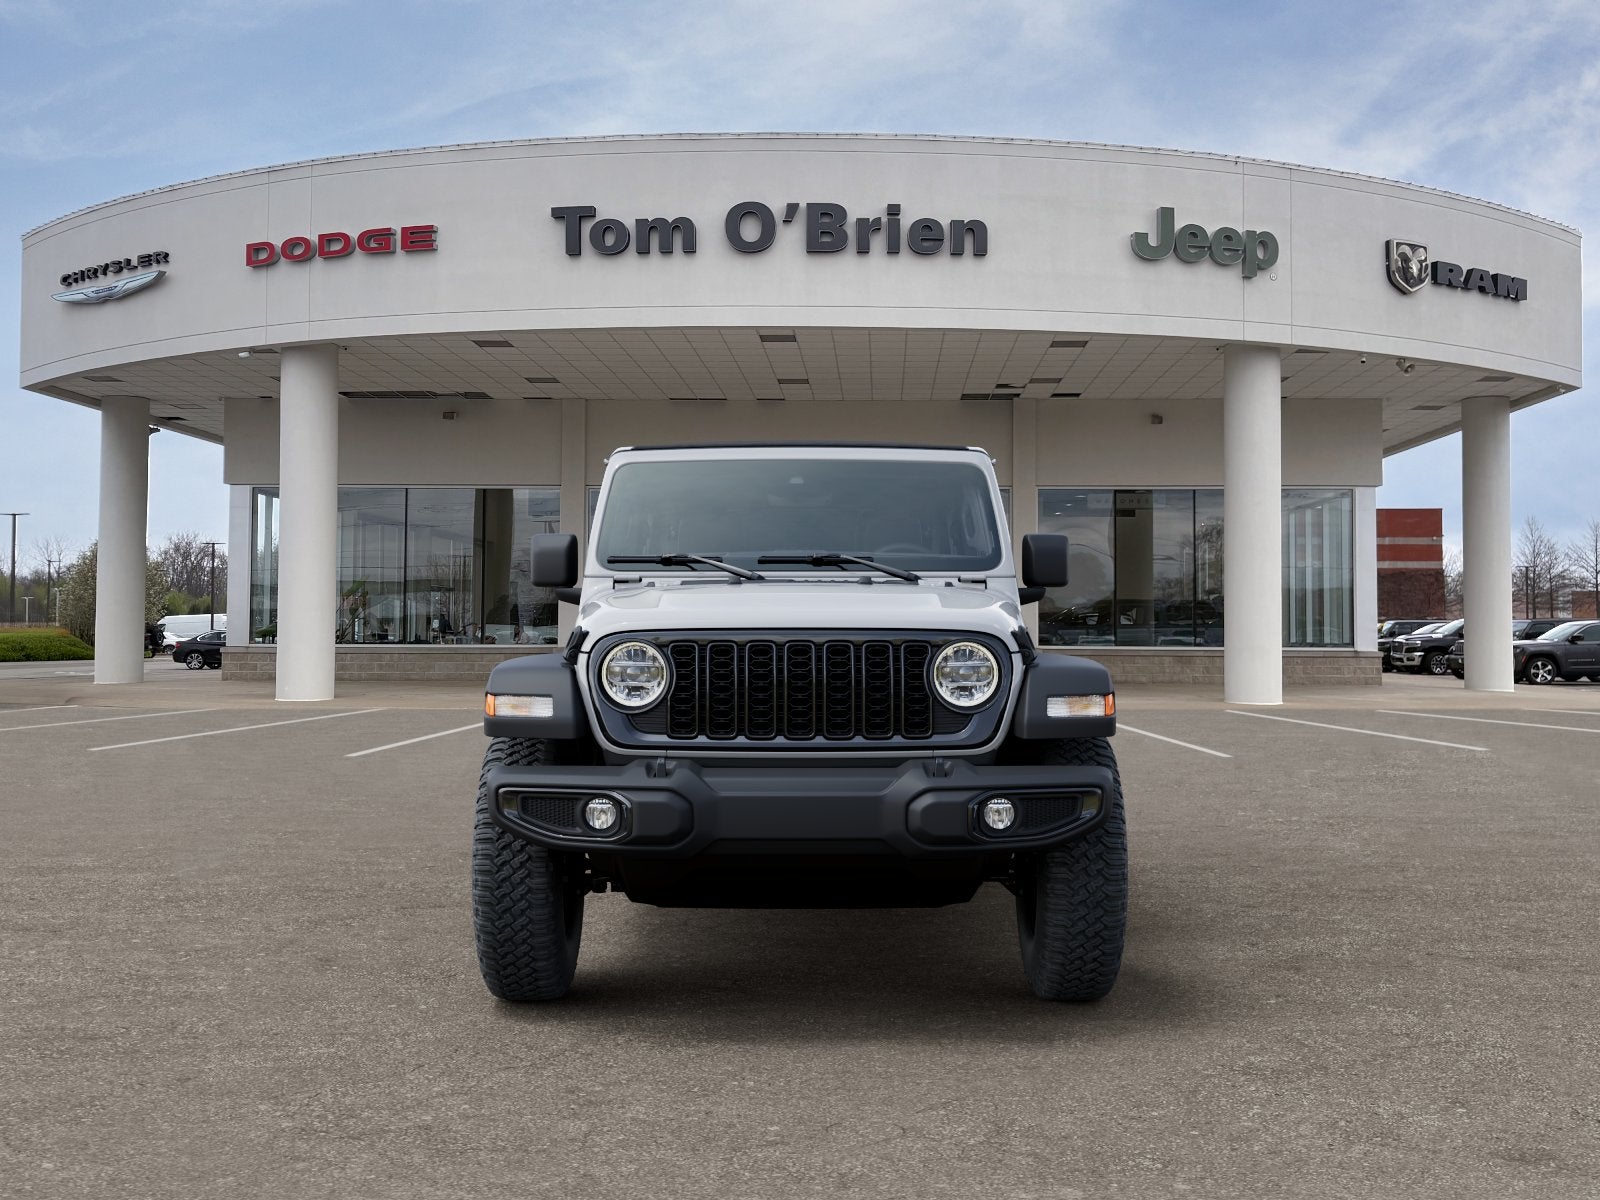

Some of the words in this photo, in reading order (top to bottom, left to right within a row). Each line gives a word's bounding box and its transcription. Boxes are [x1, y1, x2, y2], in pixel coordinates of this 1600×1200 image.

[245, 224, 438, 269] DODGE
[551, 205, 697, 256] Tom
[725, 201, 989, 256] O'Brien
[1130, 207, 1279, 279] Jeep
[60, 250, 170, 287] CHRYSLER
[1431, 260, 1528, 301] RAM
